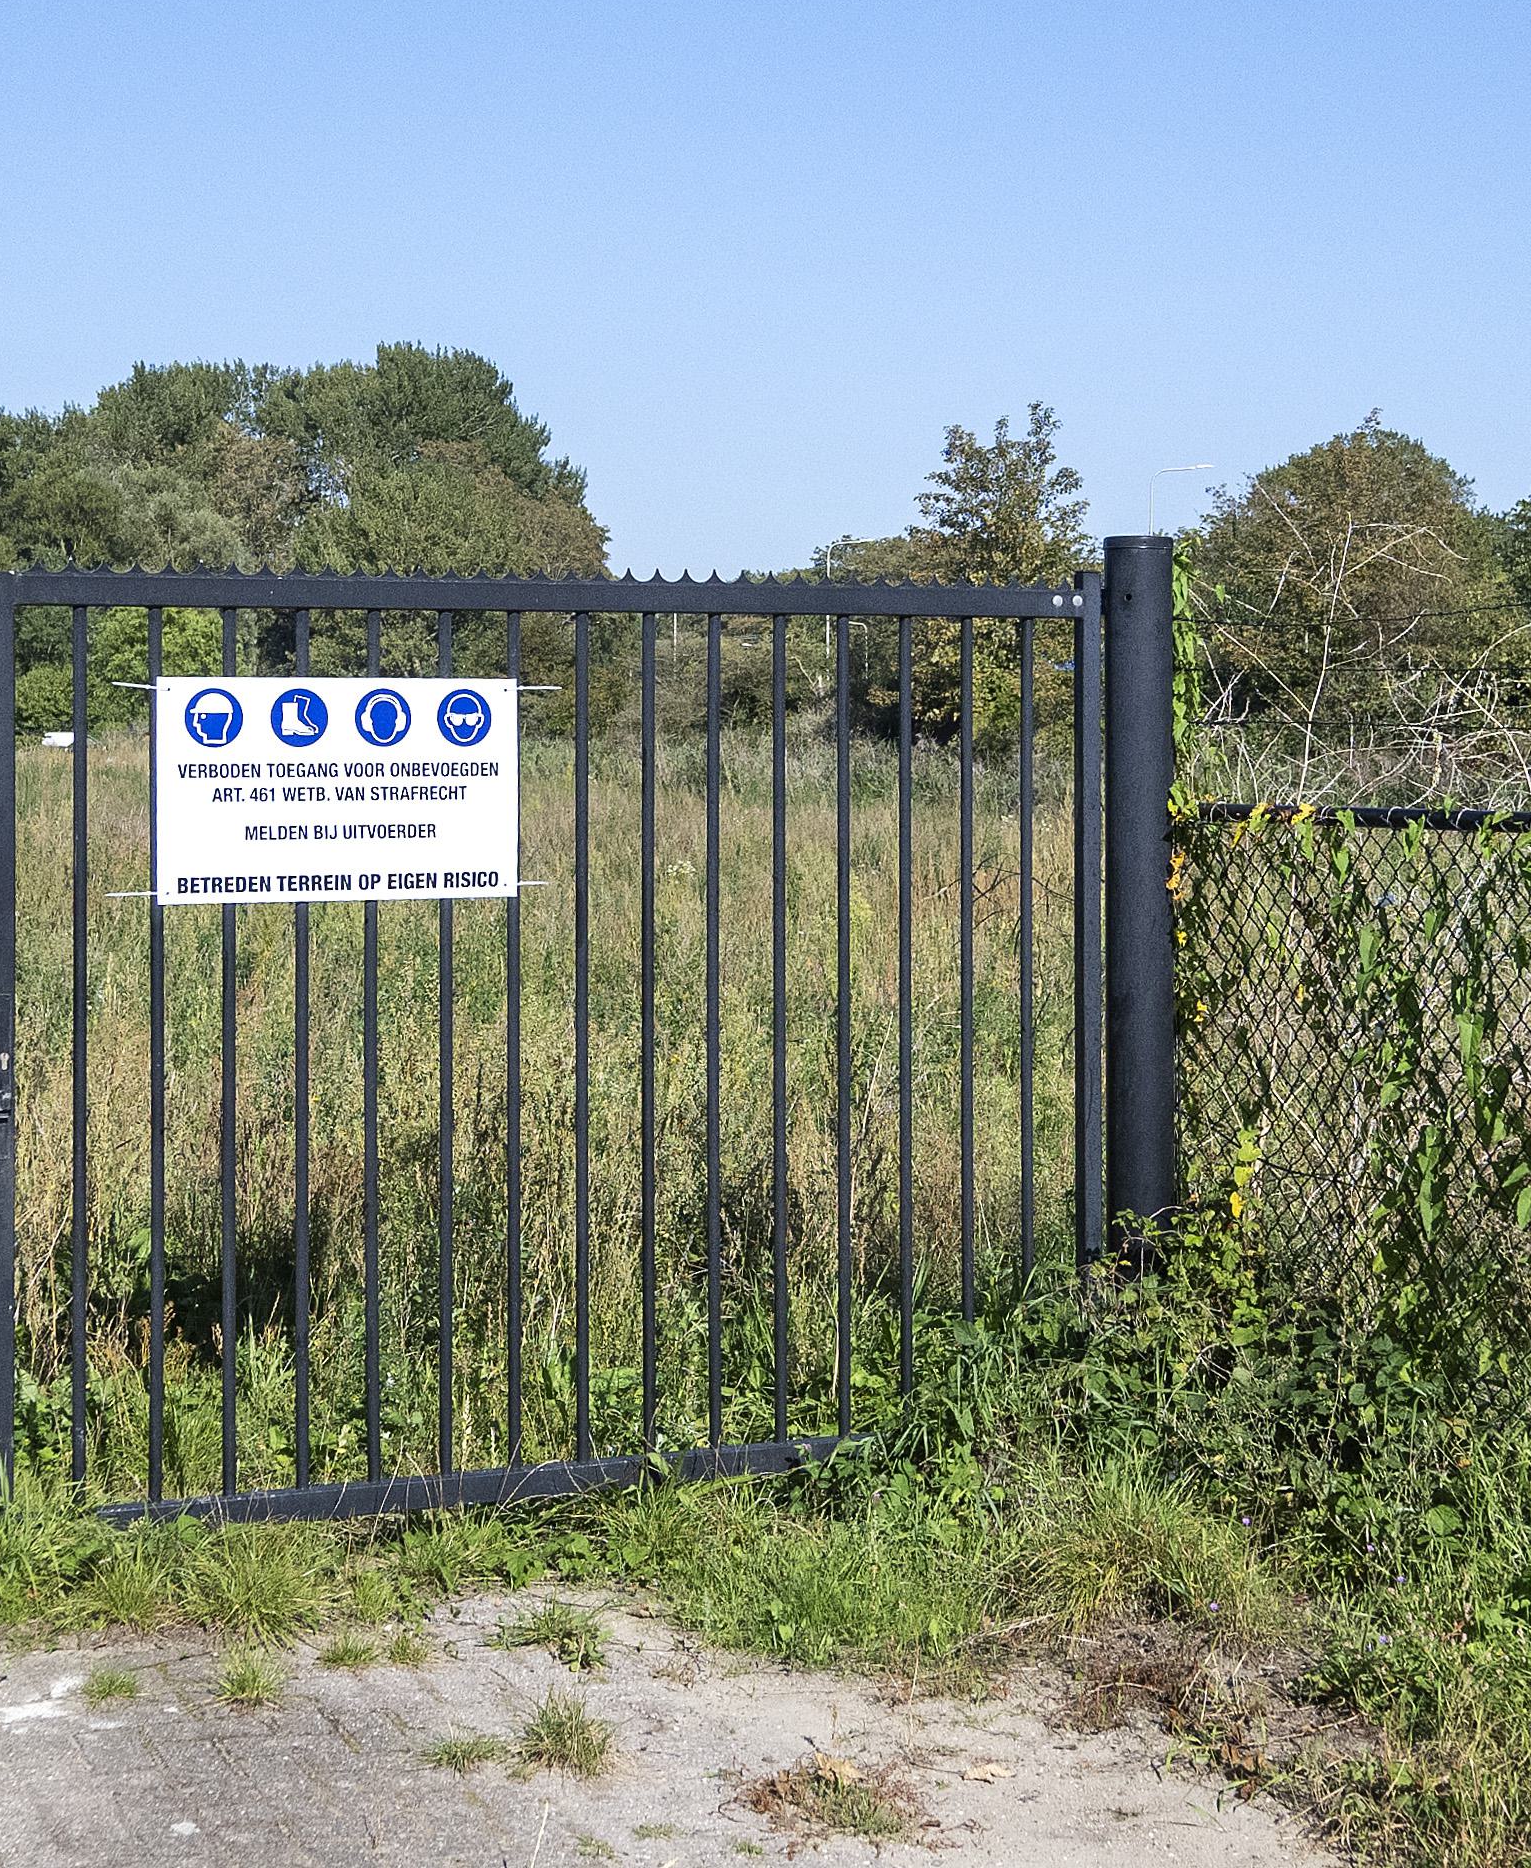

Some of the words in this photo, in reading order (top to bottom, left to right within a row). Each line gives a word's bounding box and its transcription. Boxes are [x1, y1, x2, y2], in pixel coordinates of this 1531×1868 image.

[178, 764, 260, 778] VERBODEN
[267, 763, 338, 778] TOEGANG
[344, 763, 384, 777] VOOR
[390, 762, 498, 777] ONBEVOEGDEN
[212, 788, 244, 802] ART.
[250, 788, 274, 802] 461
[283, 787, 330, 801] WETB.
[335, 787, 364, 801] VAN
[371, 786, 467, 800] STRAFRECHT
[245, 825, 308, 840] MELDEN
[314, 825, 337, 839] BIJ
[343, 824, 436, 839] UITVOERDER
[178, 876, 271, 894] BETREDEN
[277, 875, 351, 891] TERREIN
[359, 874, 381, 890] OP
[388, 873, 437, 889] EIGEN
[444, 871, 498, 888] RISICO
